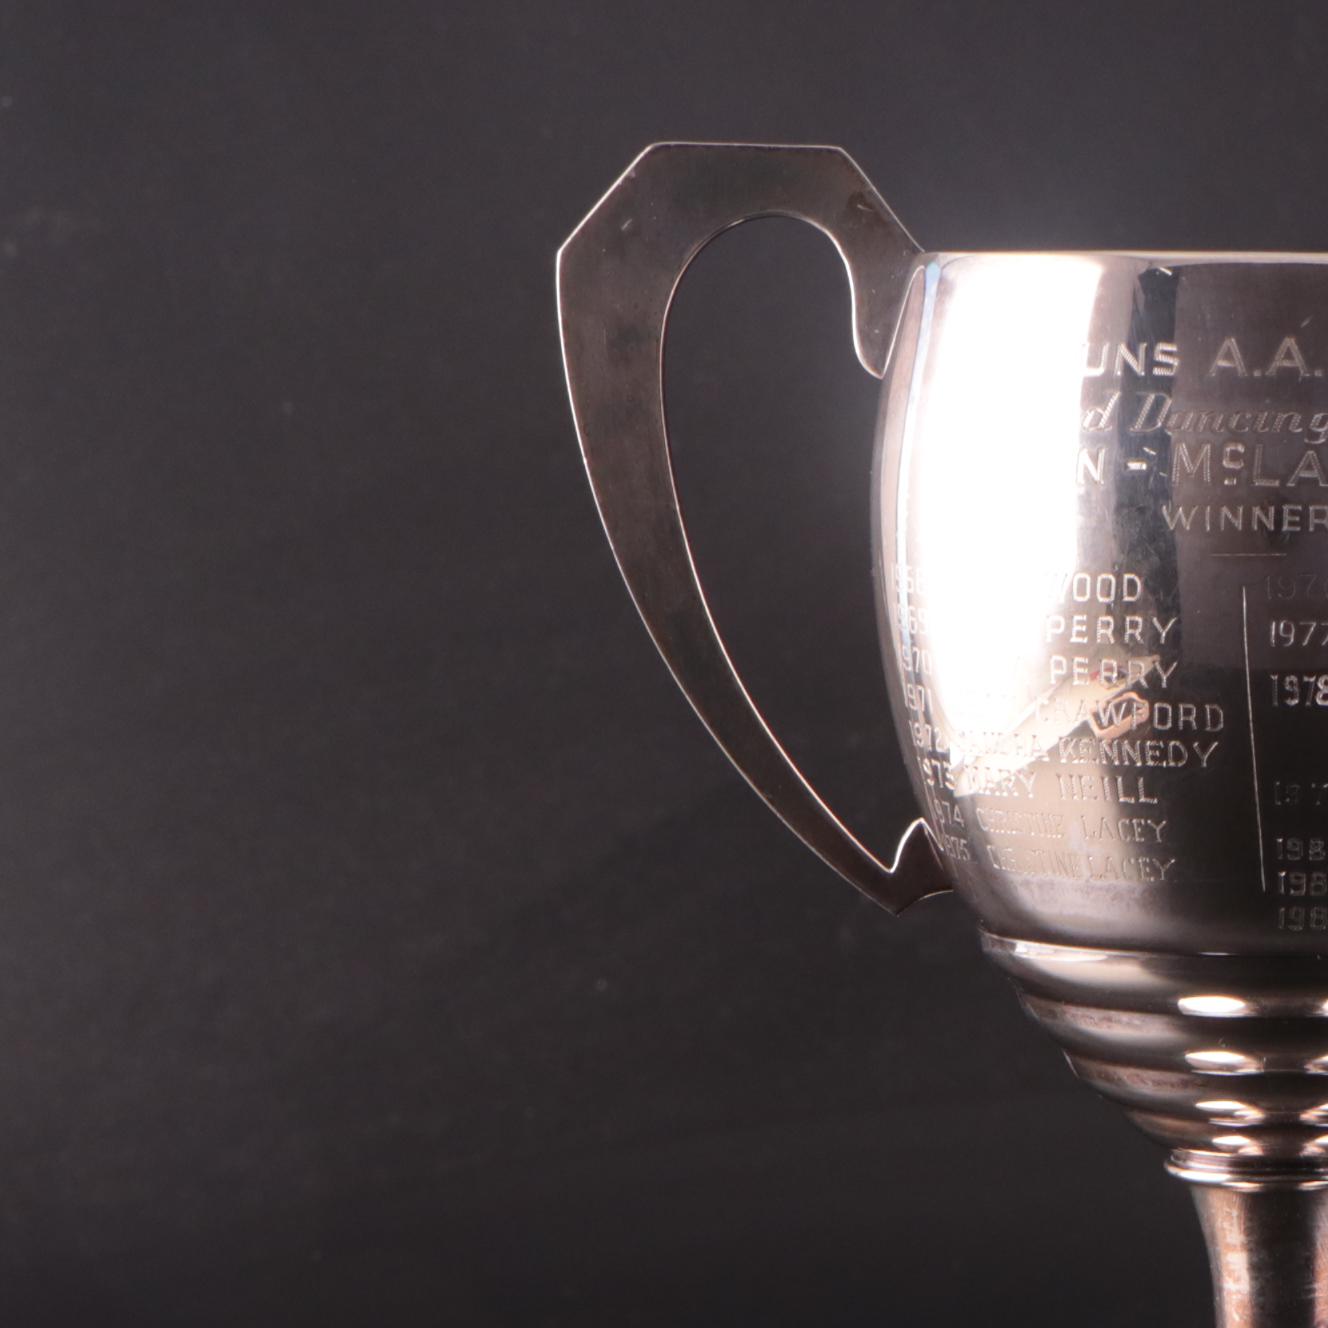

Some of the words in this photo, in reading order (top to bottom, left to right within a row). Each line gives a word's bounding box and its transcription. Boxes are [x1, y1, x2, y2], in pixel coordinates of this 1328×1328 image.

[1046, 614, 1178, 644] PERRY
[1050, 655, 1178, 689] PERRY
[1058, 735, 1219, 768] KENNEDY
[1080, 815, 1168, 843] LACEY
